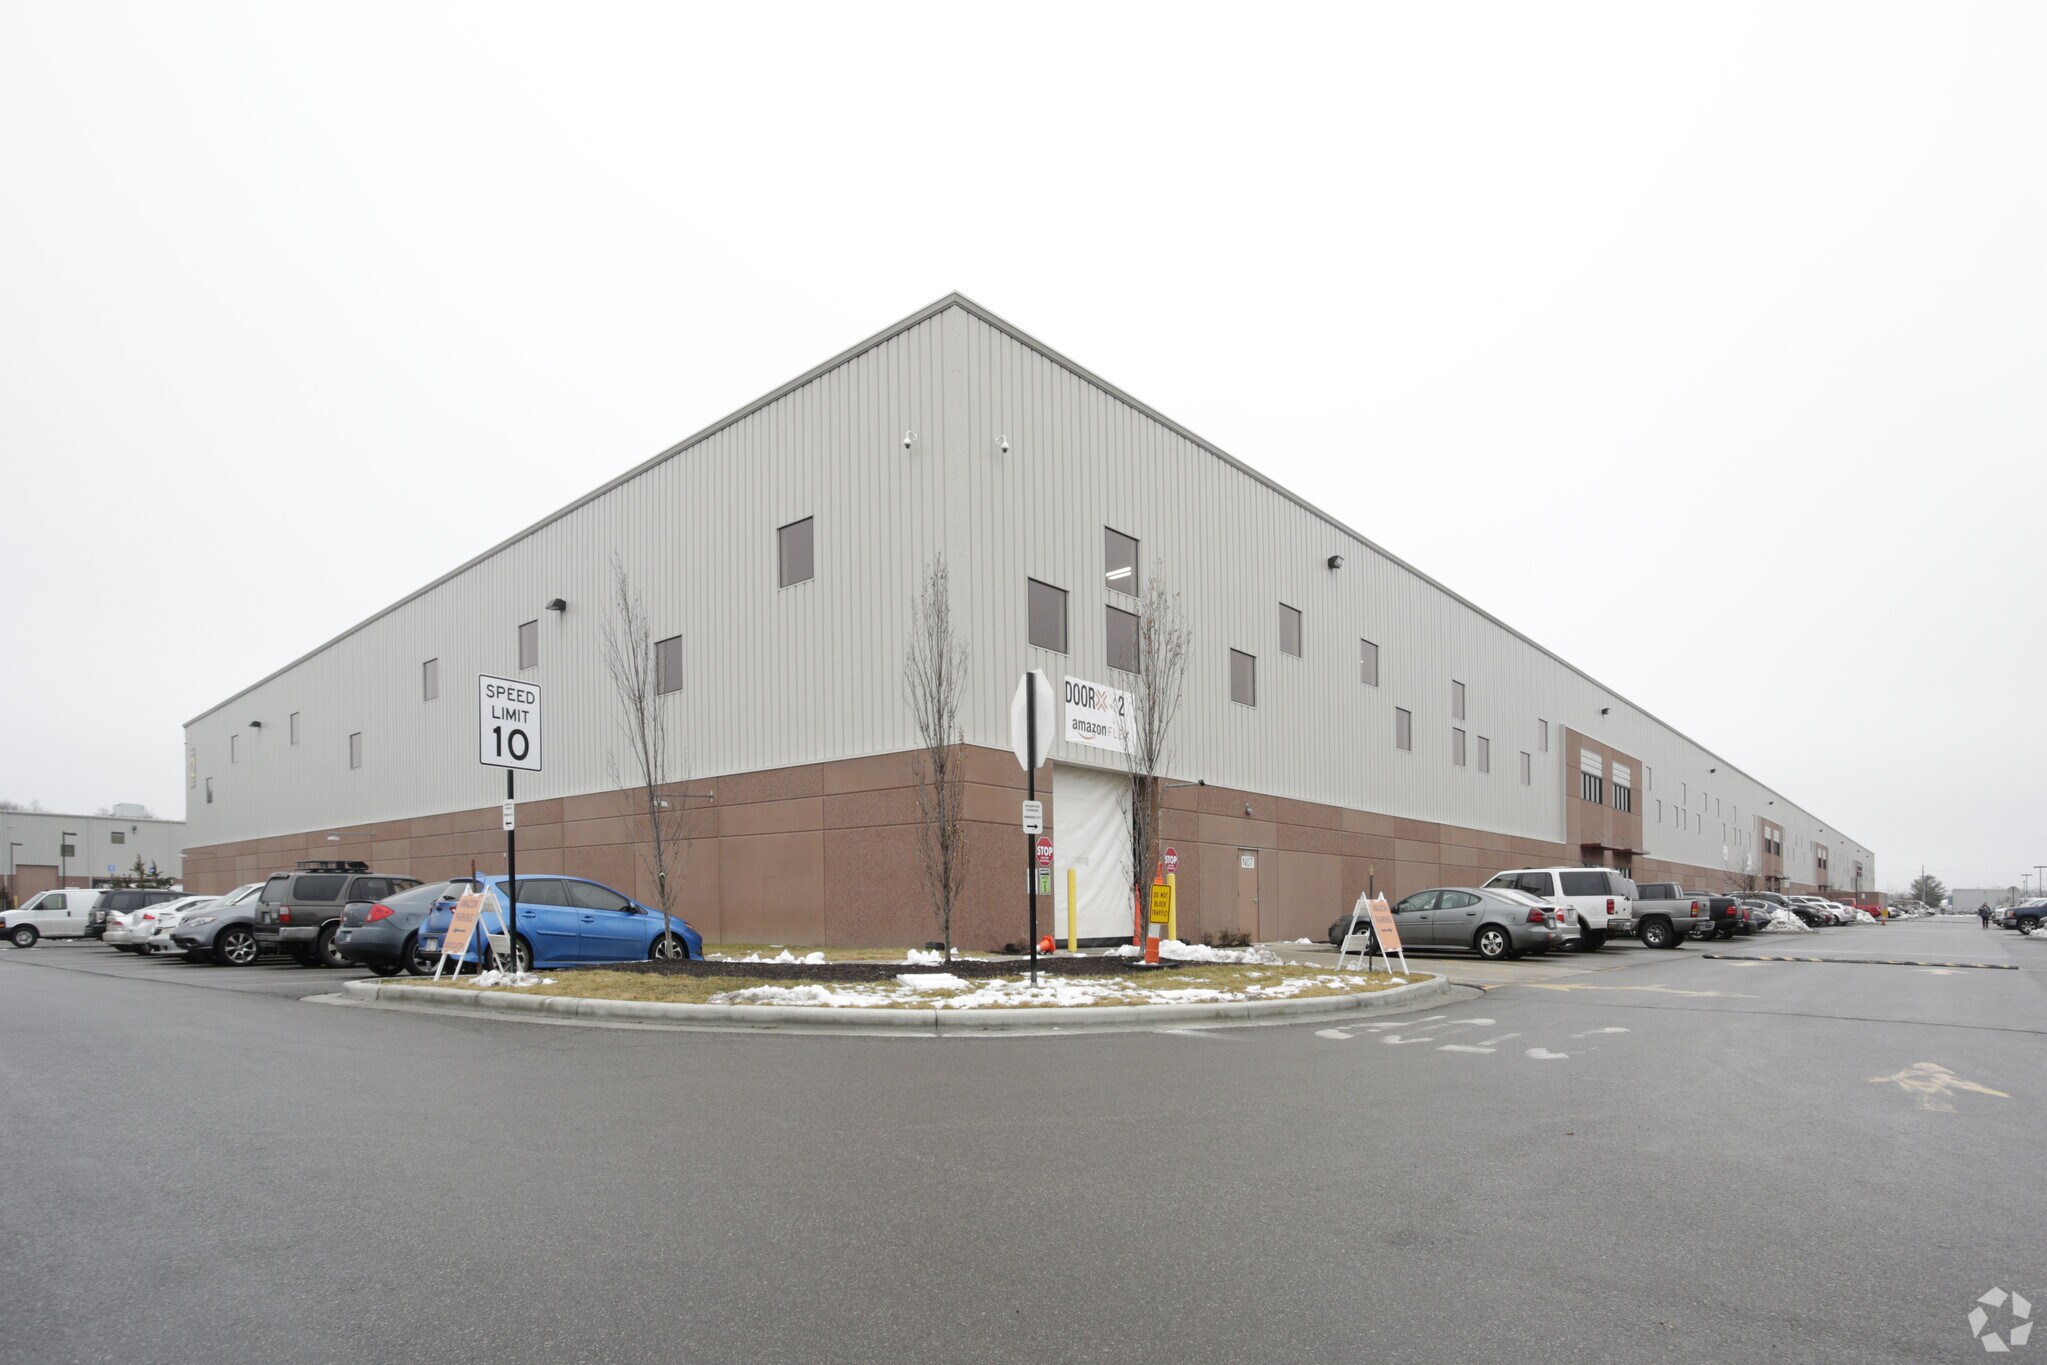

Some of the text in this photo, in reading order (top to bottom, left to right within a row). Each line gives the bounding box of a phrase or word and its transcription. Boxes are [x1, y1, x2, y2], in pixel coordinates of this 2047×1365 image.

[486, 684, 535, 704] SPEED
[492, 705, 530, 723] LIMIT
[1072, 718, 1107, 737] amazon
[493, 725, 529, 761] 10
[1037, 845, 1053, 856] STOP
[1165, 855, 1177, 864] STOP
